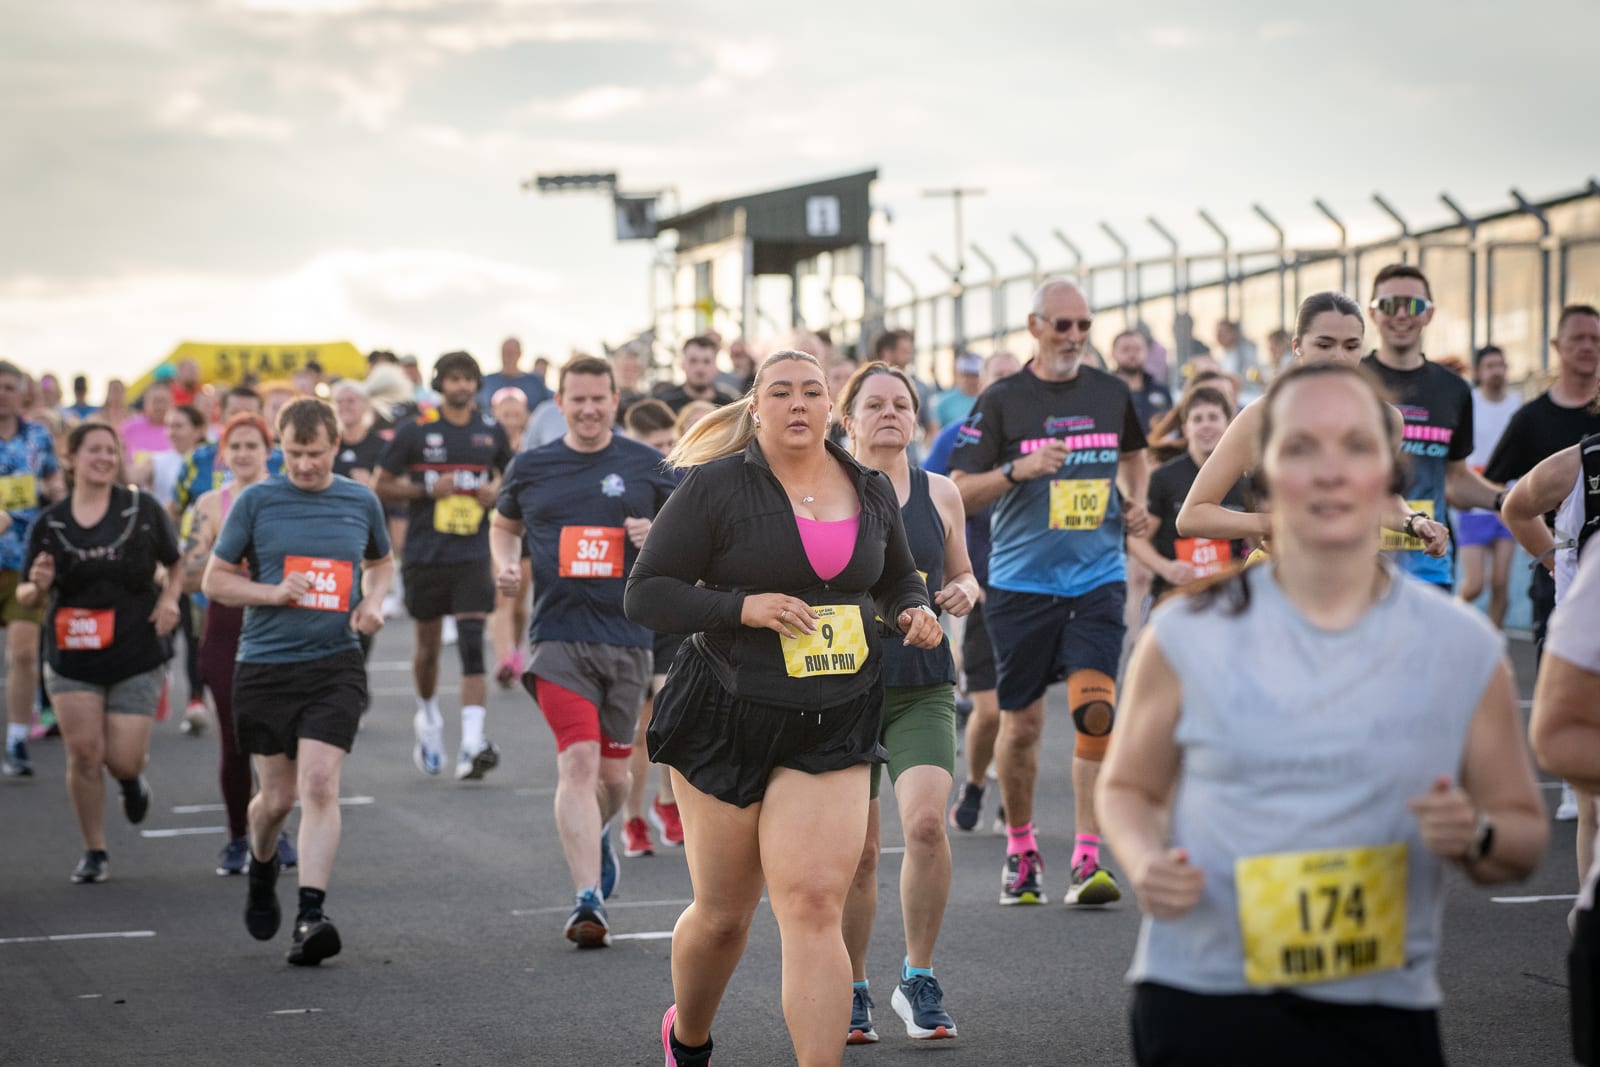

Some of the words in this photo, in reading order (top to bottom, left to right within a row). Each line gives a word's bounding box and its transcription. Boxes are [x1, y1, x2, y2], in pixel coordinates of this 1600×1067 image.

[1074, 494, 1098, 511] 100
[577, 539, 609, 560] 367
[821, 624, 834, 649] 9
[805, 654, 830, 672] RUN
[831, 653, 856, 671] PRIX
[1298, 884, 1366, 934] 174
